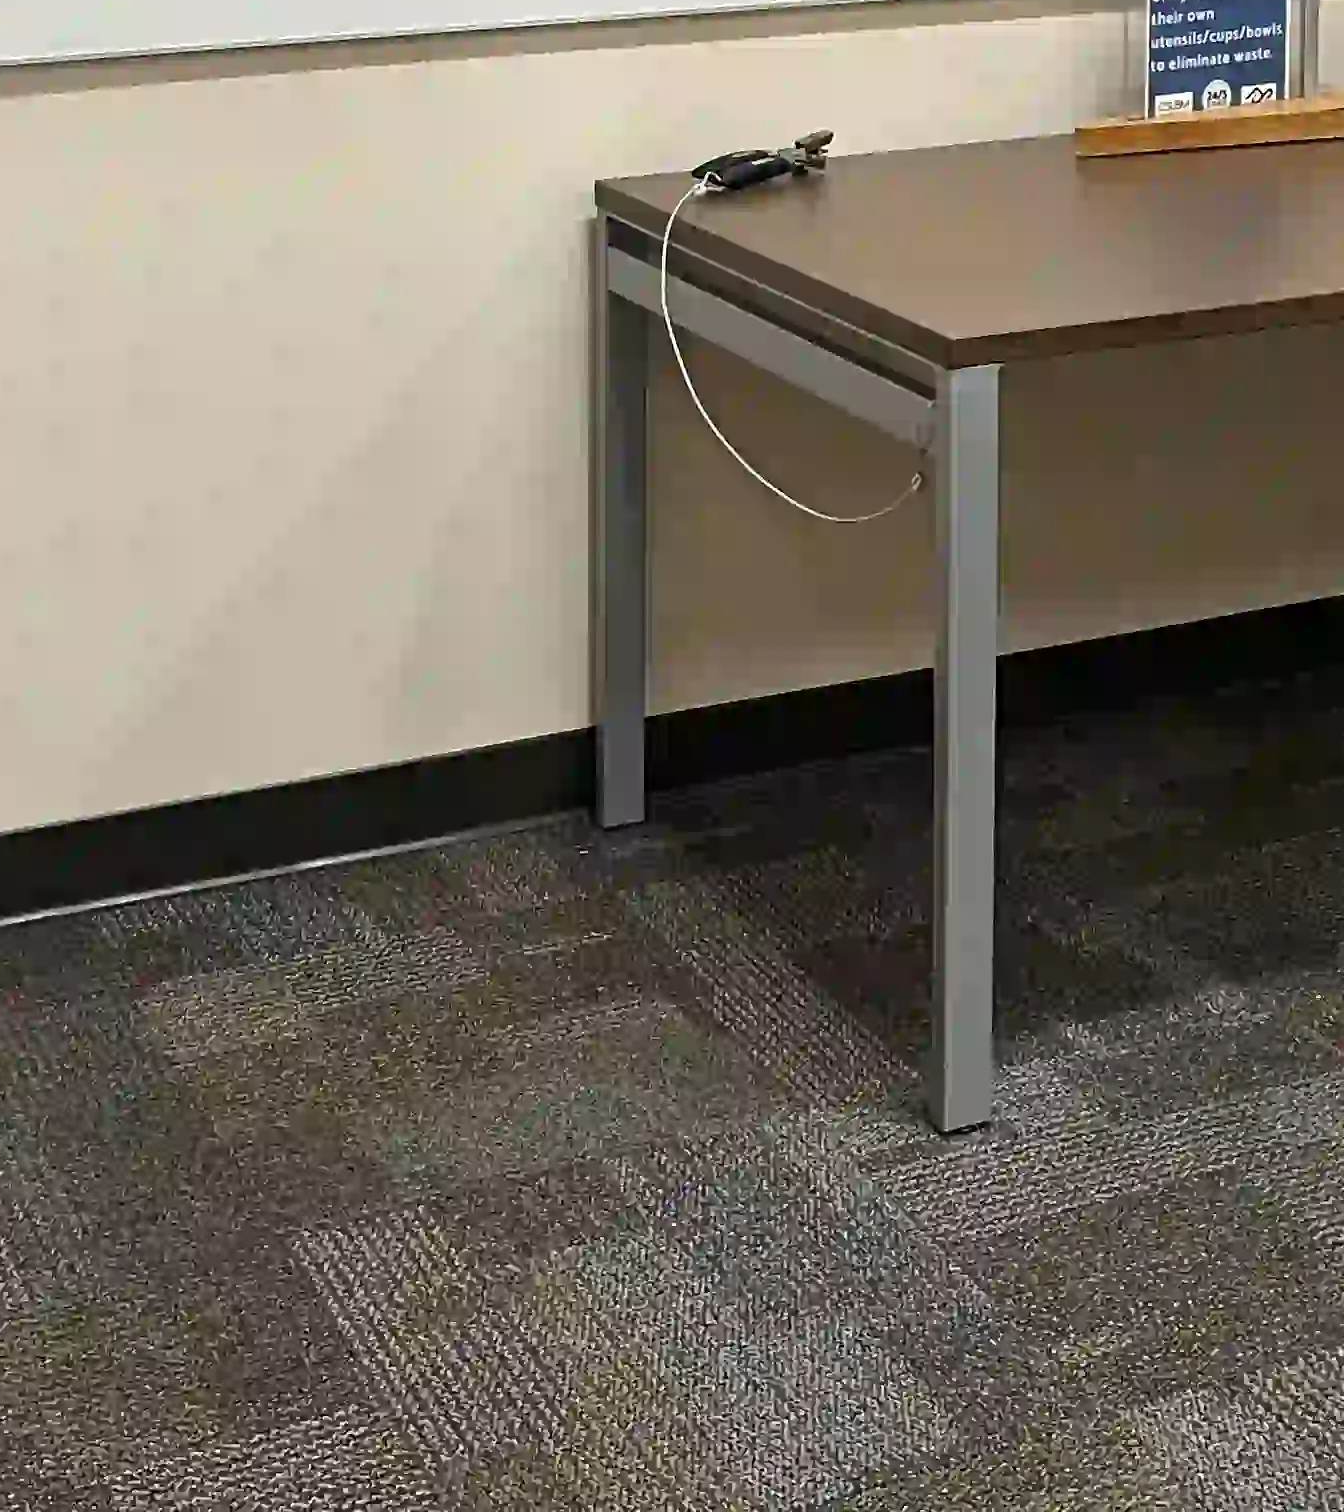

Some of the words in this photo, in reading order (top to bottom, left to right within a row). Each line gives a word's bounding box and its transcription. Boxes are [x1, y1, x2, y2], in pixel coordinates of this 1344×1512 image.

[1151, 9, 1183, 26] their
[1187, 10, 1215, 23] own
[1151, 60, 1165, 72] to
[1168, 53, 1231, 71] eliminate
